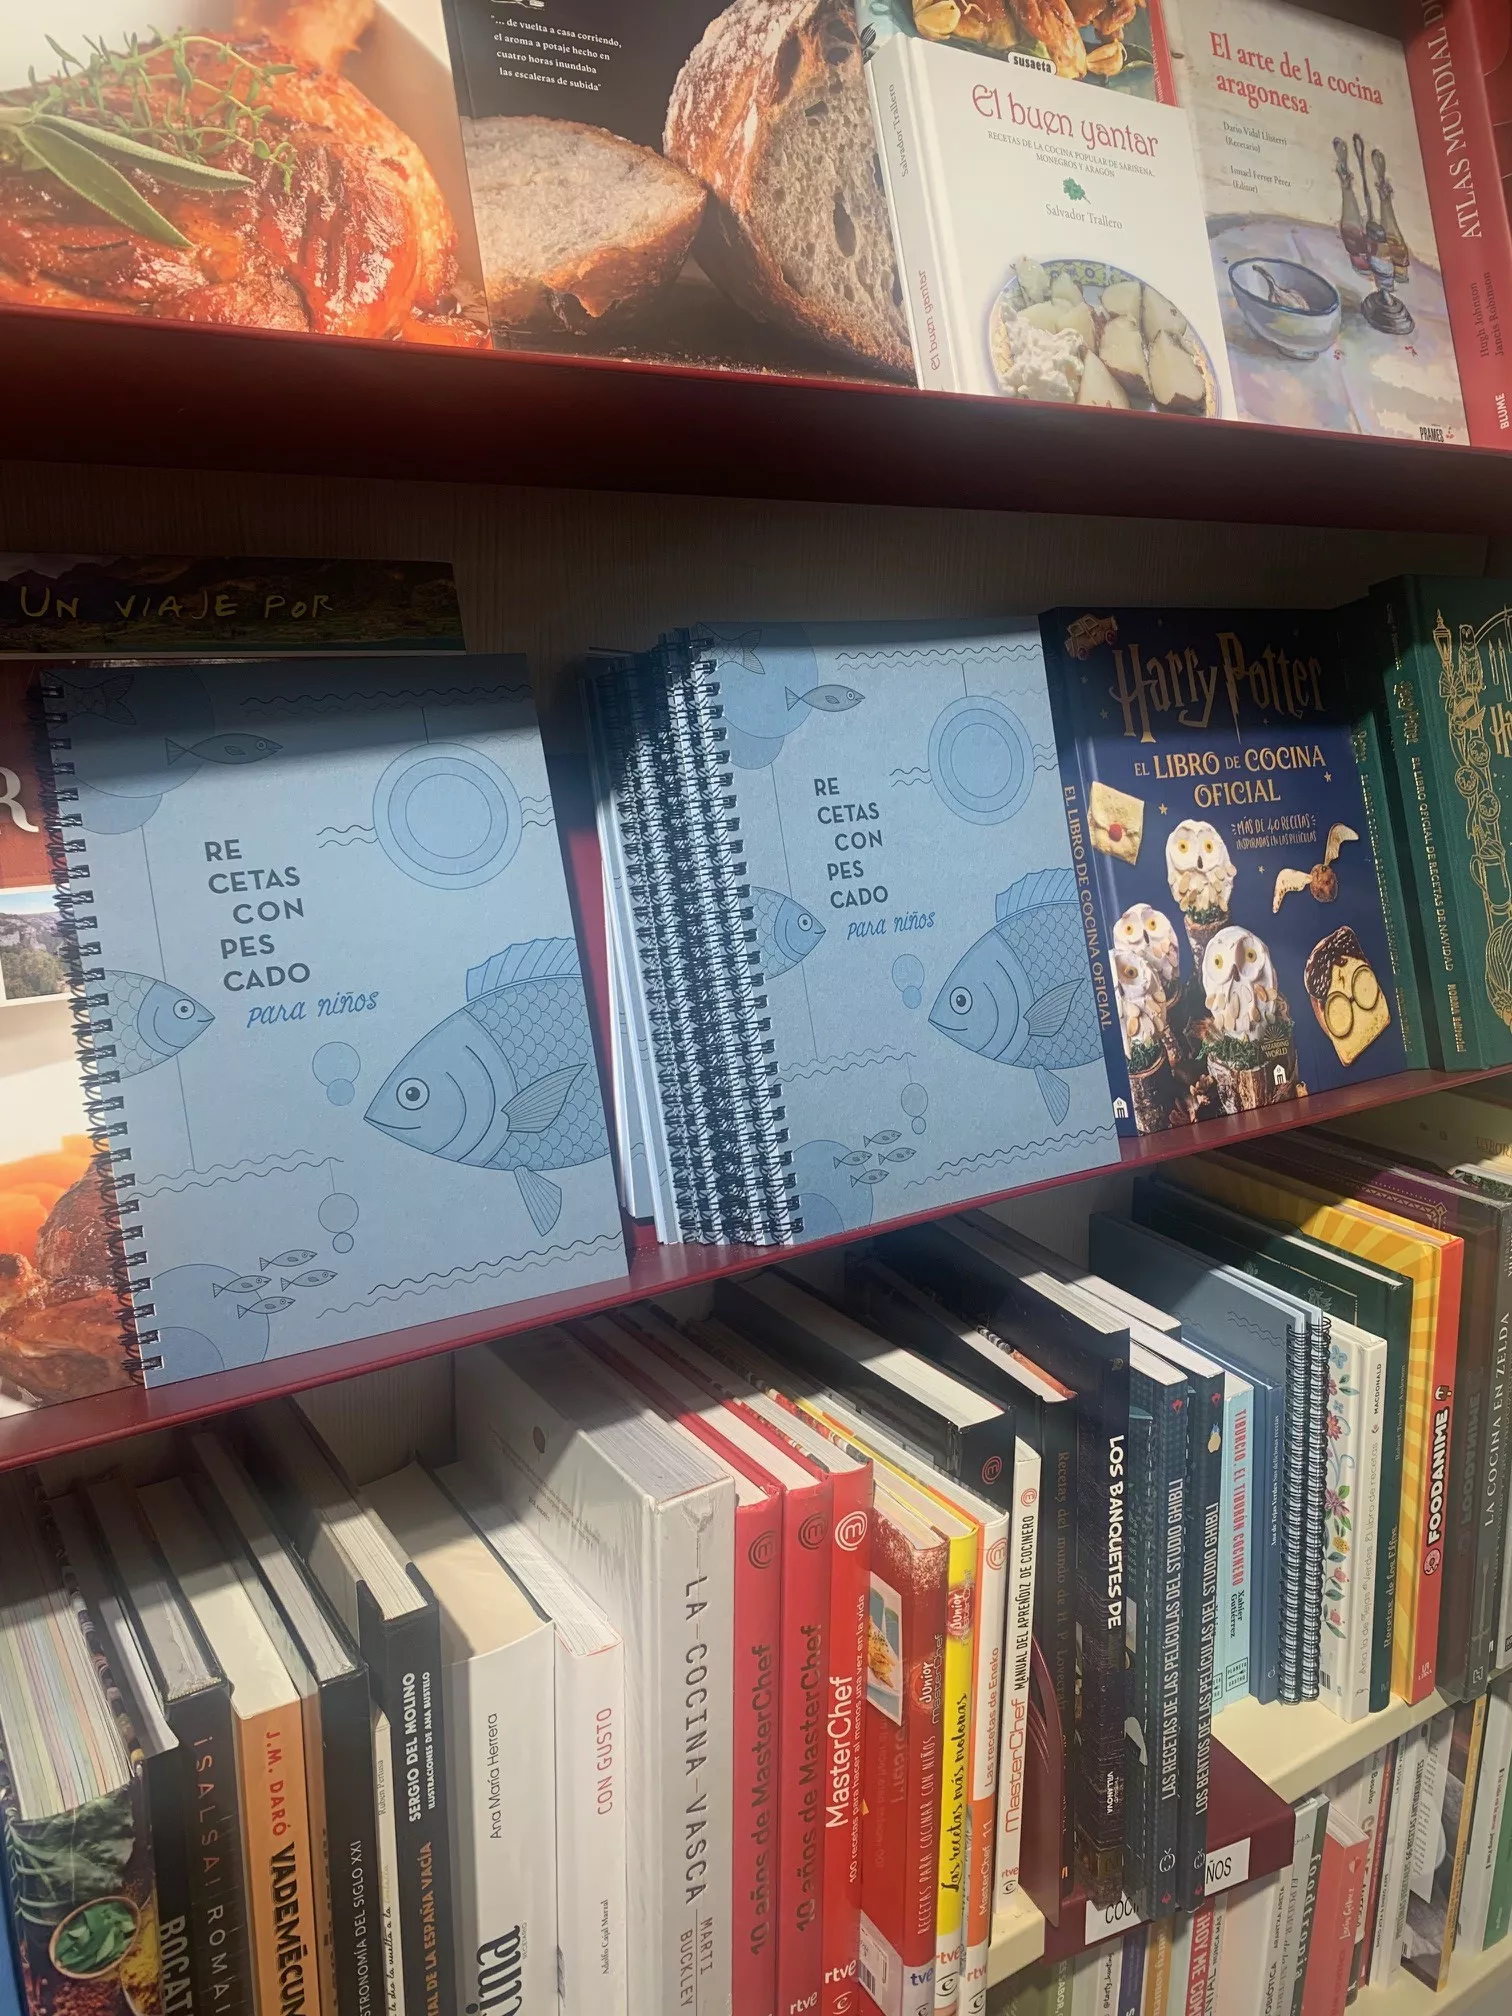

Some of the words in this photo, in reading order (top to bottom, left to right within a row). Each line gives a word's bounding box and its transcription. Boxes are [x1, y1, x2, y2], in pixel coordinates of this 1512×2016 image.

[494, 33, 502, 41] el
[504, 35, 534, 47] aroma
[536, 40, 541, 48] a
[542, 41, 570, 54] potaje
[572, 46, 598, 59] hecho
[600, 53, 610, 61] en
[496, 50, 526, 62] cuatro
[528, 54, 554, 66] horas
[556, 59, 597, 74] inundaba
[1013, 55, 1052, 73] susaeta
[1210, 31, 1232, 60] El
[1237, 48, 1275, 73] arte
[1280, 52, 1302, 81] de
[1304, 58, 1324, 88] la
[1328, 76, 1384, 106] cocina
[888, 84, 902, 128] Trallero
[1216, 74, 1310, 114] aragonesa
[972, 84, 1002, 120] El
[1007, 92, 1074, 138] buen
[1080, 120, 1158, 157] yantar
[897, 126, 908, 177] Salvador
[1046, 204, 1086, 222] Salvador
[1088, 212, 1122, 230] Trallero
[1483, 271, 1498, 326] Robinson
[1492, 326, 1504, 356] Jancis
[1495, 392, 1509, 430] BLUME
[1419, 426, 1444, 443] PRAMES
[1108, 643, 1217, 744] Harry
[1214, 632, 1327, 745] Potter
[1134, 762, 1150, 777] EL
[1153, 752, 1220, 779] LIBRO
[1224, 756, 1241, 770] DE
[1244, 745, 1326, 772] COCINA
[813, 777, 840, 797] RE
[1064, 786, 1076, 806] EL
[1194, 778, 1281, 808] OFICIAL
[1414, 771, 1426, 800] LIBRO
[817, 802, 880, 824] CETAS
[204, 839, 242, 862] RE
[834, 830, 883, 851] CON
[1066, 808, 1086, 860] LIBRO
[1426, 846, 1436, 860] DE
[208, 866, 300, 894] CETAS
[826, 860, 864, 881] PES
[1074, 863, 1088, 888] DE
[1429, 862, 1444, 906] RECETAS
[232, 898, 305, 924] CON
[830, 886, 888, 908] CADO
[1436, 908, 1446, 922] DE
[846, 918, 887, 940] para
[894, 911, 936, 932] niños
[1080, 890, 1099, 958] COCINA
[220, 934, 276, 960] PES
[1439, 924, 1454, 972] NAVIDAD
[222, 962, 311, 992] CADO
[1092, 961, 1114, 1031] OFICIAL
[246, 1001, 307, 1029] para
[317, 990, 380, 1018] niños
[1496, 1312, 1510, 1380] ZELDA
[1374, 1364, 1382, 1415] MACDONALD
[1494, 1386, 1503, 1412] EN
[1108, 1434, 1124, 1478] LOS
[1234, 1408, 1247, 1466] TIBURCIO,
[1234, 1468, 1246, 1479] EL
[1426, 1407, 1449, 1547] FOODANIME
[1487, 1430, 1502, 1498] COCINA
[1168, 1478, 1183, 1526] GHIBLI
[1233, 1480, 1246, 1538] TIBURÓN
[1484, 1501, 1496, 1526] LA
[1020, 1514, 1034, 1565] COCINERO
[1108, 1482, 1124, 1598] BANQUETES
[1205, 1502, 1219, 1547] GHIBLI
[1166, 1527, 1182, 1571] STUDIO
[1232, 1539, 1245, 1587] COCINERO
[1020, 1566, 1032, 1580] DE
[1166, 1573, 1180, 1600] DEL
[1204, 1548, 1218, 1594] STUDIO
[686, 1576, 708, 1620] LA
[1017, 1582, 1031, 1628] APRENDIZ
[1108, 1600, 1122, 1630] DE
[1202, 1596, 1215, 1624] DEL
[1230, 1594, 1238, 1638] Gutiérrez
[1016, 1630, 1029, 1651] DEL
[1163, 1601, 1180, 1672] PELÍCULAS
[1014, 1652, 1030, 1690] MANUAL
[1199, 1624, 1214, 1690] PELÍCULAS
[402, 1672, 416, 1733] MOLINO
[1164, 1673, 1178, 1698] LAS
[686, 1644, 708, 1776] COCINA
[799, 1624, 822, 1786] MasterChef
[1164, 1699, 1178, 1718] DE
[1199, 1692, 1212, 1718] LAS
[486, 1712, 498, 1764] Herrera
[596, 1707, 612, 1772] GUSTO
[752, 1643, 772, 1808] MasterChef
[1198, 1718, 1212, 1740] DE
[404, 1734, 419, 1766] DEL
[826, 1676, 853, 1830] MasterChef
[920, 1735, 936, 1772] NIÑOS
[1163, 1718, 1178, 1776] RECETAS
[1196, 1740, 1210, 1792] BENTOS
[408, 1769, 422, 1823] SERGIO
[488, 1766, 500, 1810] María
[597, 1776, 614, 1816] CON
[798, 1788, 818, 1824] de
[920, 1776, 934, 1802] CON
[1106, 1771, 1114, 1814] VILLANOVA
[1162, 1777, 1176, 1800] LAS
[1196, 1792, 1208, 1815] LOS
[490, 1812, 502, 1840] Ana
[751, 1808, 771, 1846] de
[919, 1806, 934, 1851] COCINAR
[417, 1840, 432, 1890] VACÍA
[686, 1793, 707, 1905] VASCA
[797, 1826, 817, 1894] años
[918, 1852, 932, 1883] PARA
[750, 1852, 771, 1917] años
[1001, 1866, 1018, 1880] rtve
[420, 1890, 436, 1949] ESPAÑA
[796, 1898, 815, 1932] 10
[917, 1884, 932, 1936] RECETAS
[700, 1916, 713, 1976] MARTI
[750, 1920, 770, 1956] 10
[424, 1950, 436, 1970] LA
[680, 1929, 693, 2008] BUCKLEY
[824, 1960, 856, 1984] rtve
[426, 1972, 438, 1991] DE
[790, 1990, 818, 2016] rtve
